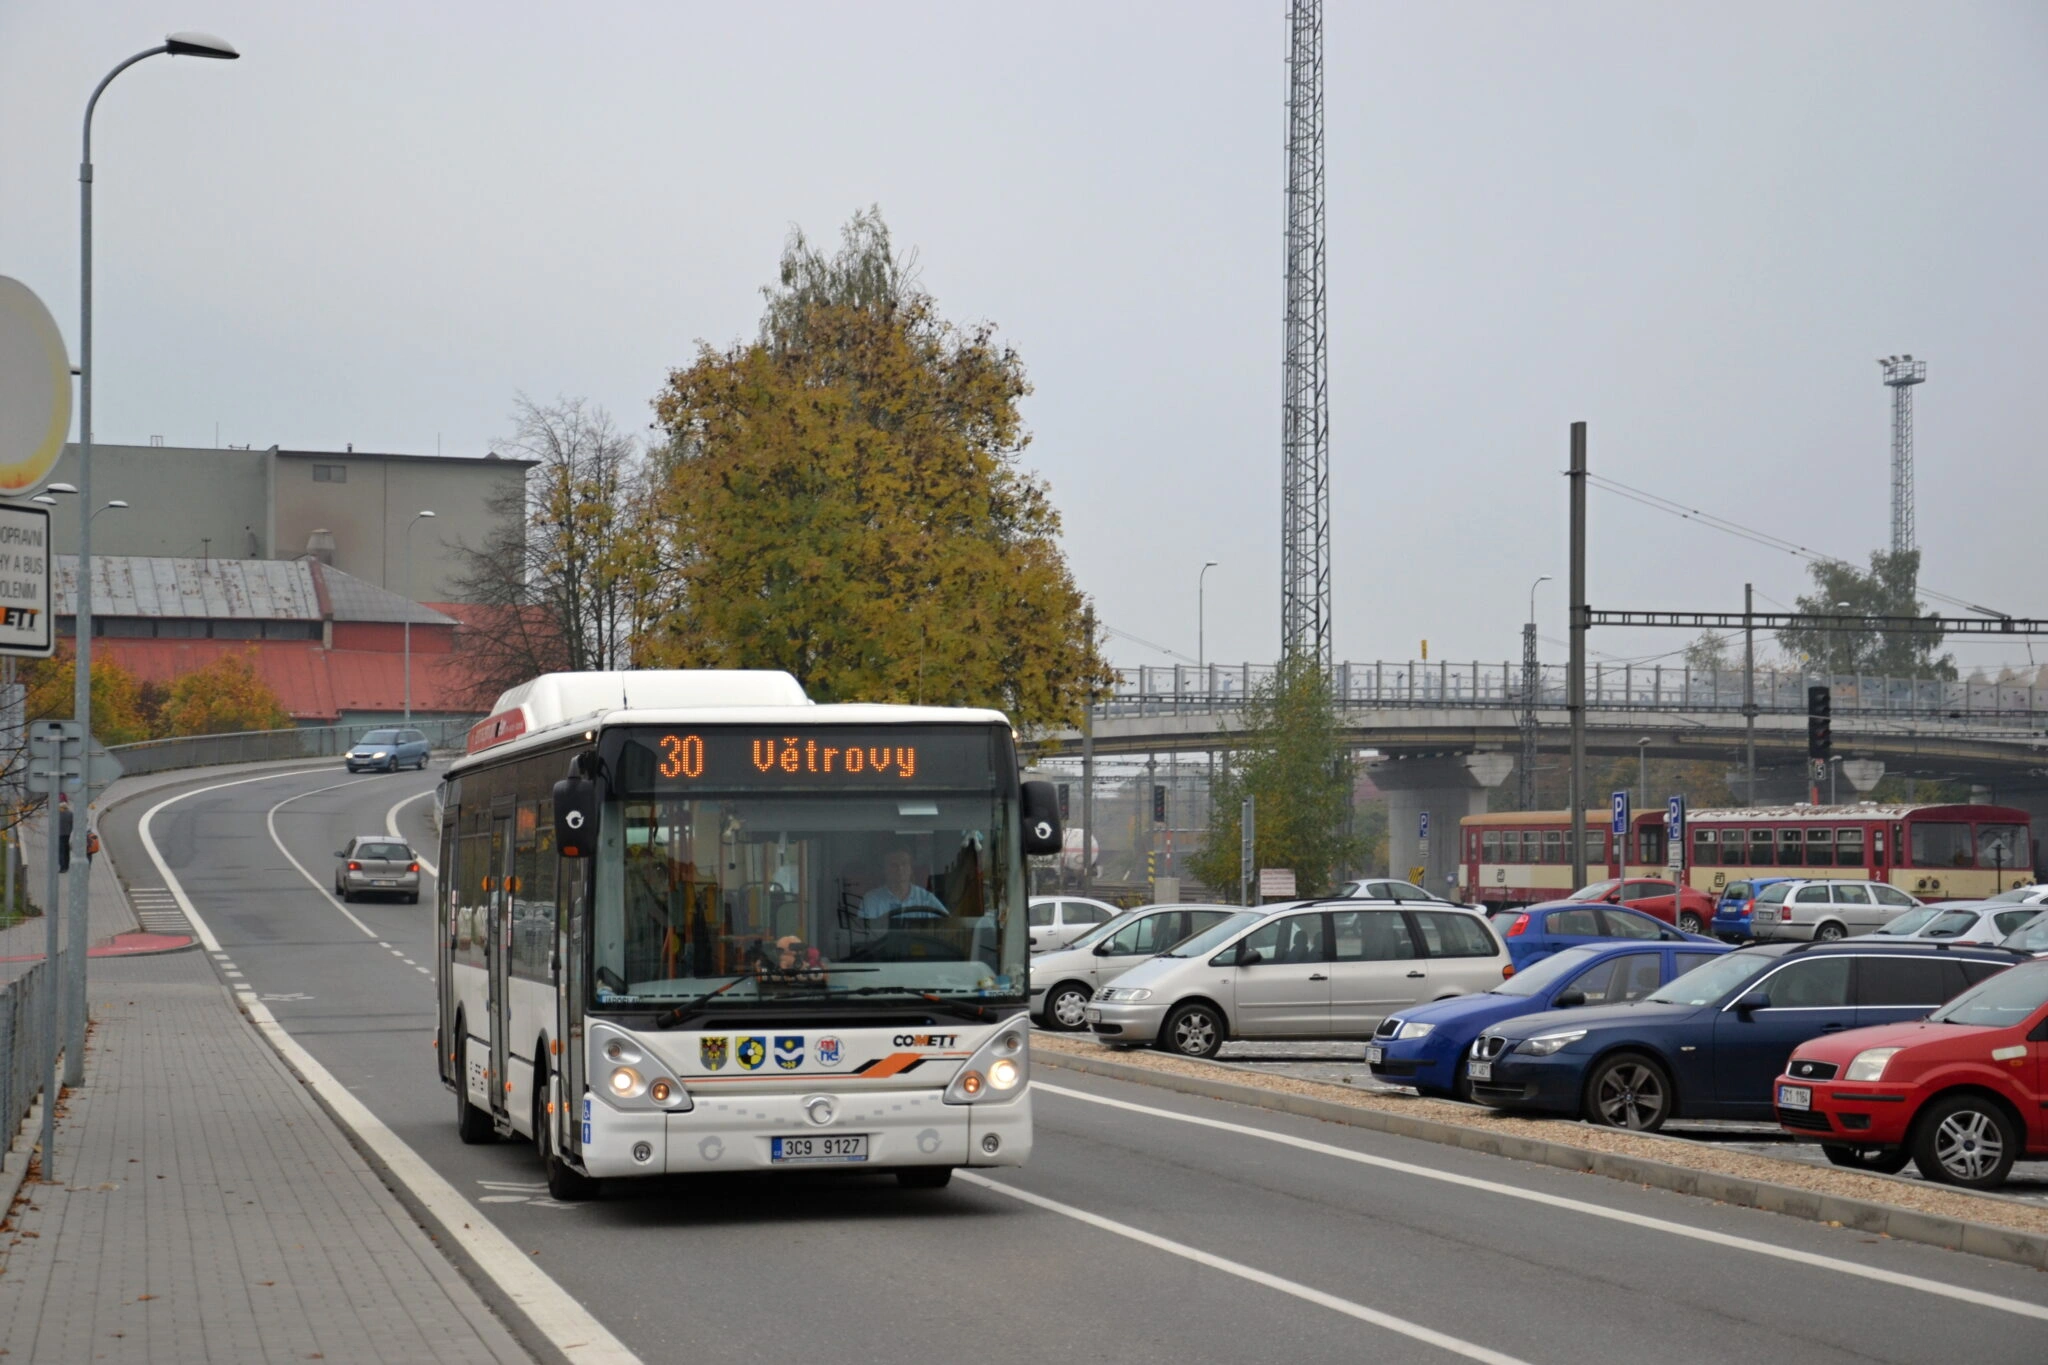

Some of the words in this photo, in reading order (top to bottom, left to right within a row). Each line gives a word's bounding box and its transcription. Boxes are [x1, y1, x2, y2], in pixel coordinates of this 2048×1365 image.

[0, 526, 42, 547] OPRAVNÍ
[14, 556, 21, 573] A
[24, 556, 42, 575] BUS
[660, 735, 704, 777] 30
[753, 737, 915, 777] Větrovy
[1615, 796, 1623, 821] P
[1671, 801, 1679, 825] P
[893, 1034, 961, 1047] COMETT
[785, 1140, 812, 1155] 3C9
[824, 1138, 860, 1154] 9127
